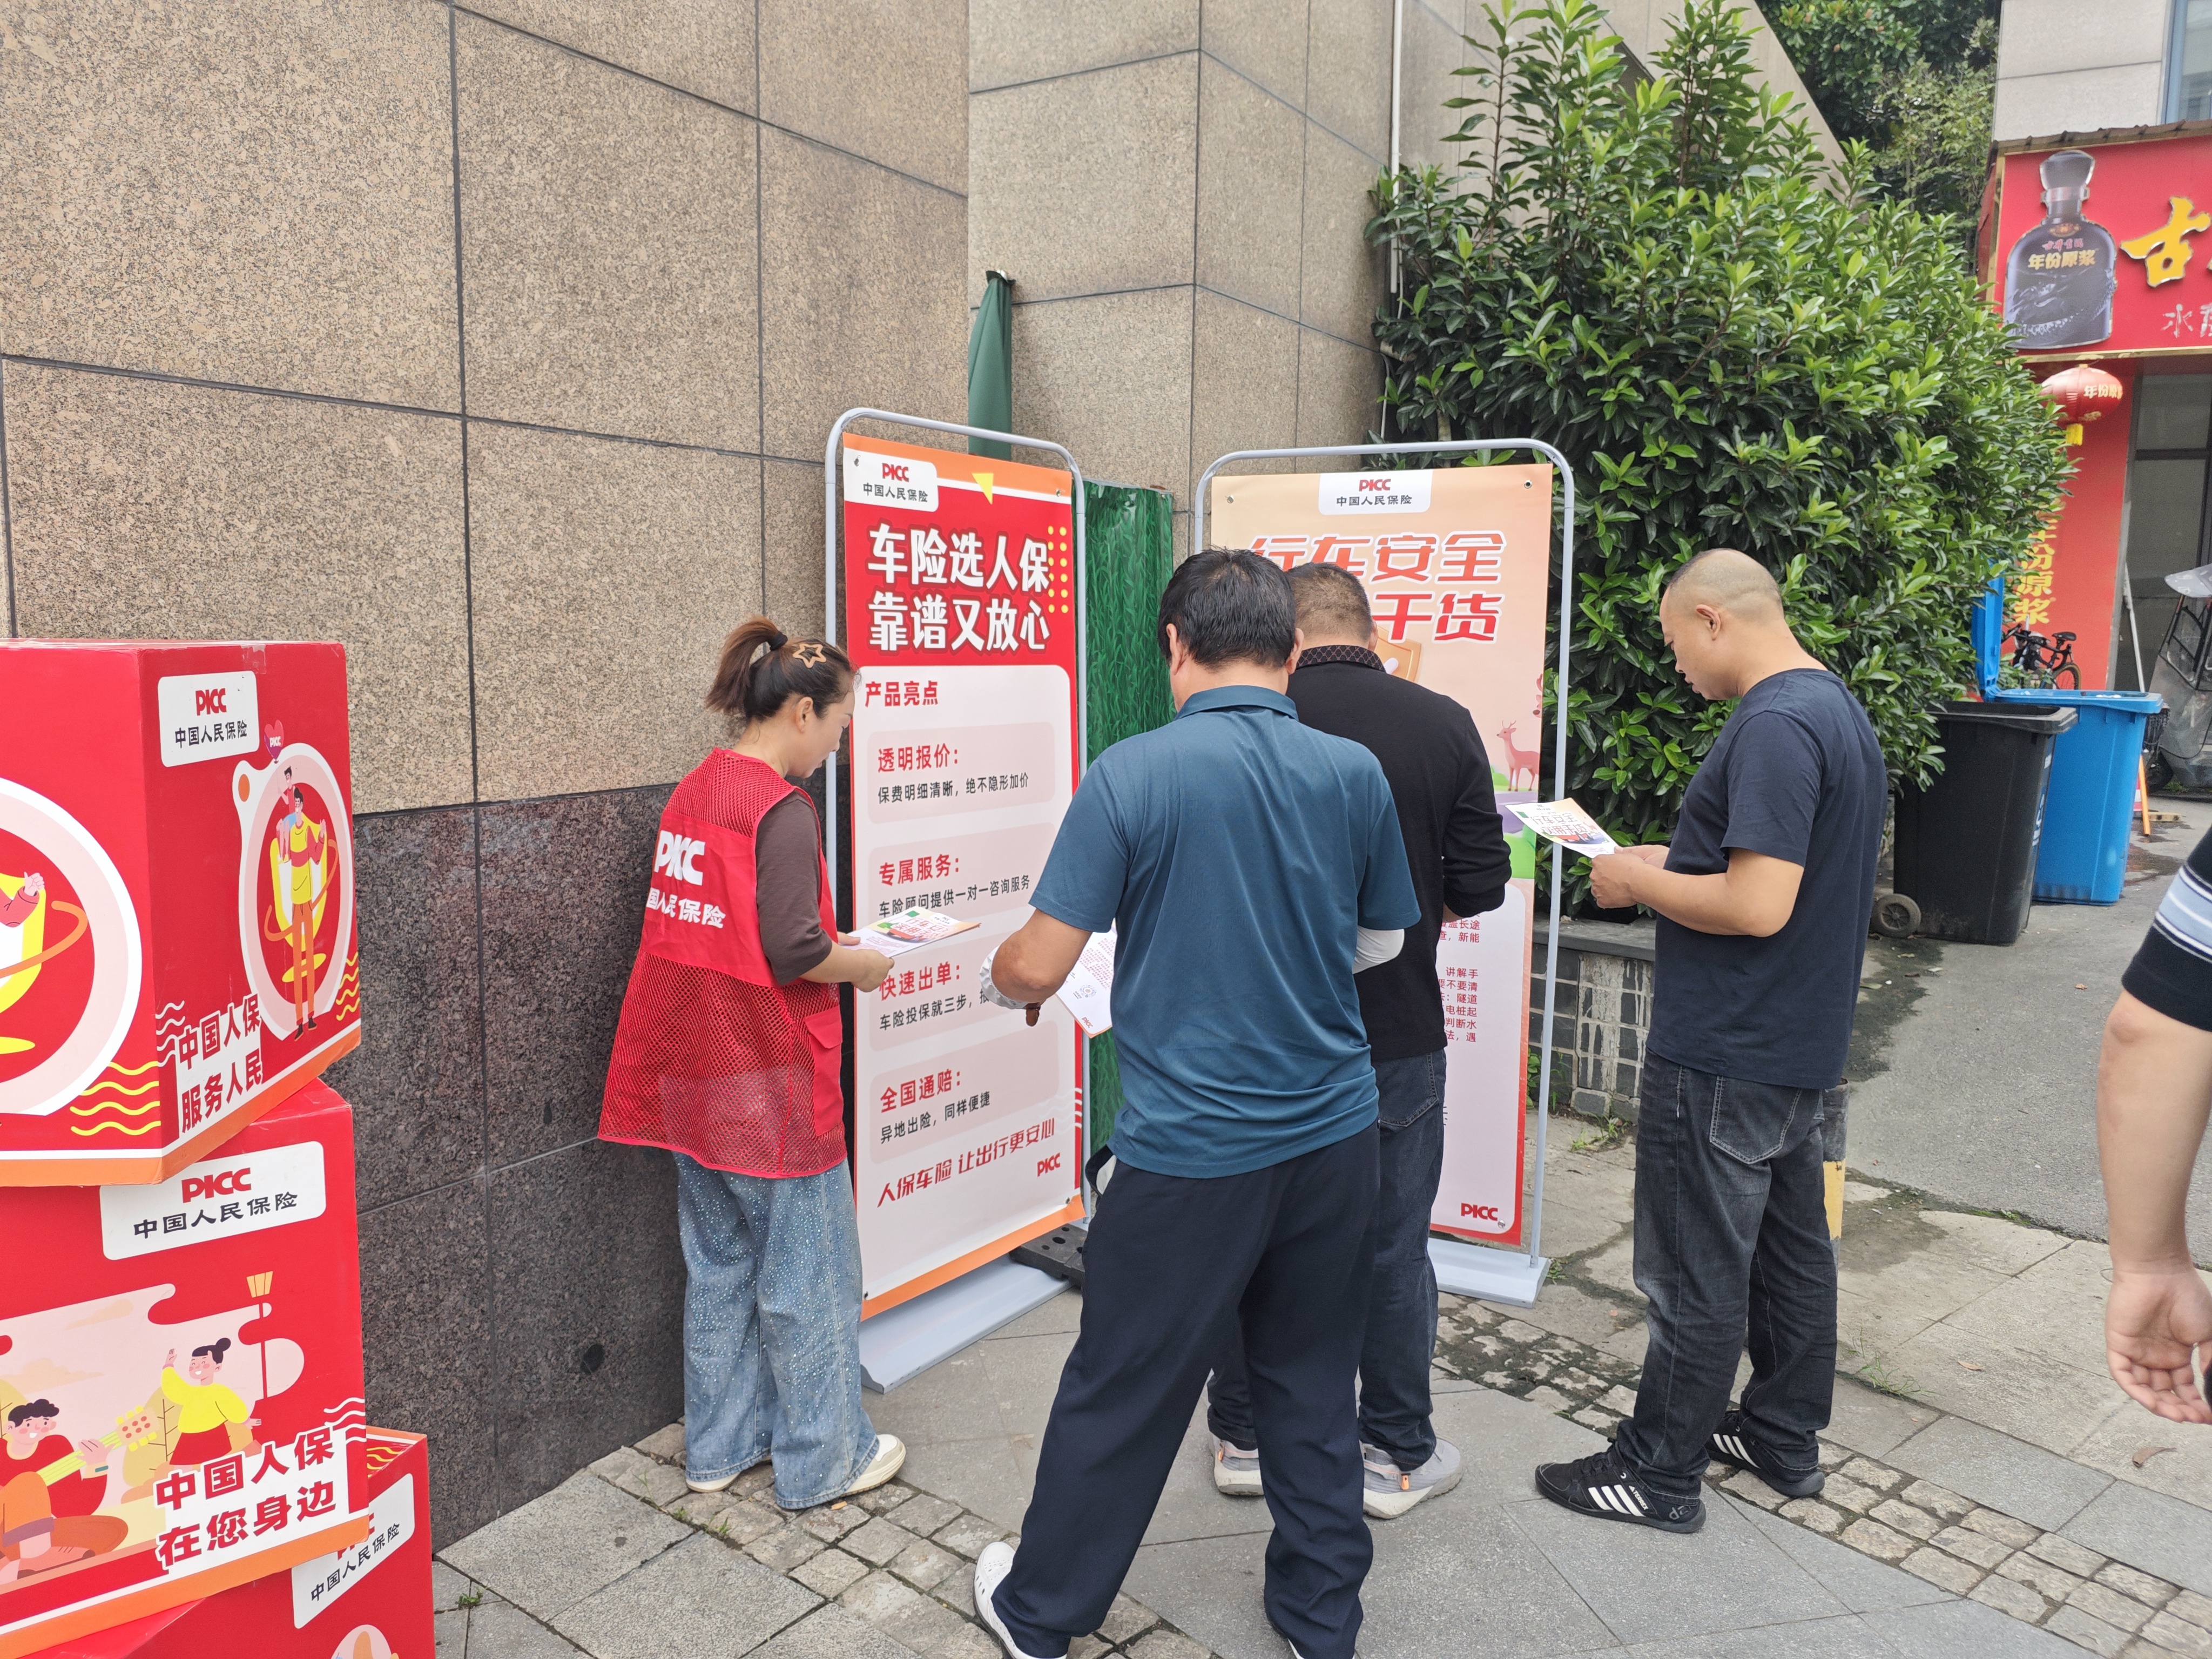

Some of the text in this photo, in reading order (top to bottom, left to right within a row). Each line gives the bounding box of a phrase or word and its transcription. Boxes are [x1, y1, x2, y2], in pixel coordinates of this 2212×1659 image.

[2120, 196, 2212, 288] 古
[2028, 249, 2095, 270] 年份原浆
[882, 463, 909, 482] PICC
[1359, 479, 1391, 491] PICC
[863, 482, 928, 502] 中国人民保险
[1337, 495, 1412, 507] 中国人民保险
[868, 524, 1050, 592] 车险选人保
[868, 591, 1050, 651] 靠谱又放心
[195, 688, 227, 716] PICC
[865, 681, 938, 707] 产品亮点
[175, 720, 247, 748] 中国人民保险
[269, 736, 281, 747] PICC
[878, 743, 958, 773] 透明报价：
[878, 772, 1029, 804] 保费明细清晰，绝不隐形加价
[1530, 813, 1577, 825] 行车安全
[654, 830, 705, 886] PICC
[879, 854, 959, 886] 专属服务：
[646, 887, 726, 928] 国人民保险
[879, 874, 1030, 918] 车险顾问提供一对一咨询服务
[879, 961, 960, 1001] 快速出单：
[1446, 967, 1478, 979] 讲解手
[179, 994, 261, 1070] 中国人保
[1082, 1017, 1093, 1028] PICC
[1445, 1017, 1477, 1029] 判断水
[182, 1048, 263, 1133] 服务人民
[880, 1069, 960, 1113] 全国通赔：
[881, 1091, 990, 1144] 异地出险，同样便捷
[877, 1117, 1054, 1208] 人保车险 让出行更安心
[1037, 1153, 1061, 1177] PICC
[181, 1168, 251, 1203] PICC
[133, 1192, 297, 1239] 中国人民保险
[1461, 1203, 1498, 1221] PICC
[156, 1427, 335, 1510] 中国人保
[1633, 1490, 1648, 1510] TERREX
[158, 1481, 336, 1567] 在您身边
[311, 1523, 400, 1601] 中国人民保险
